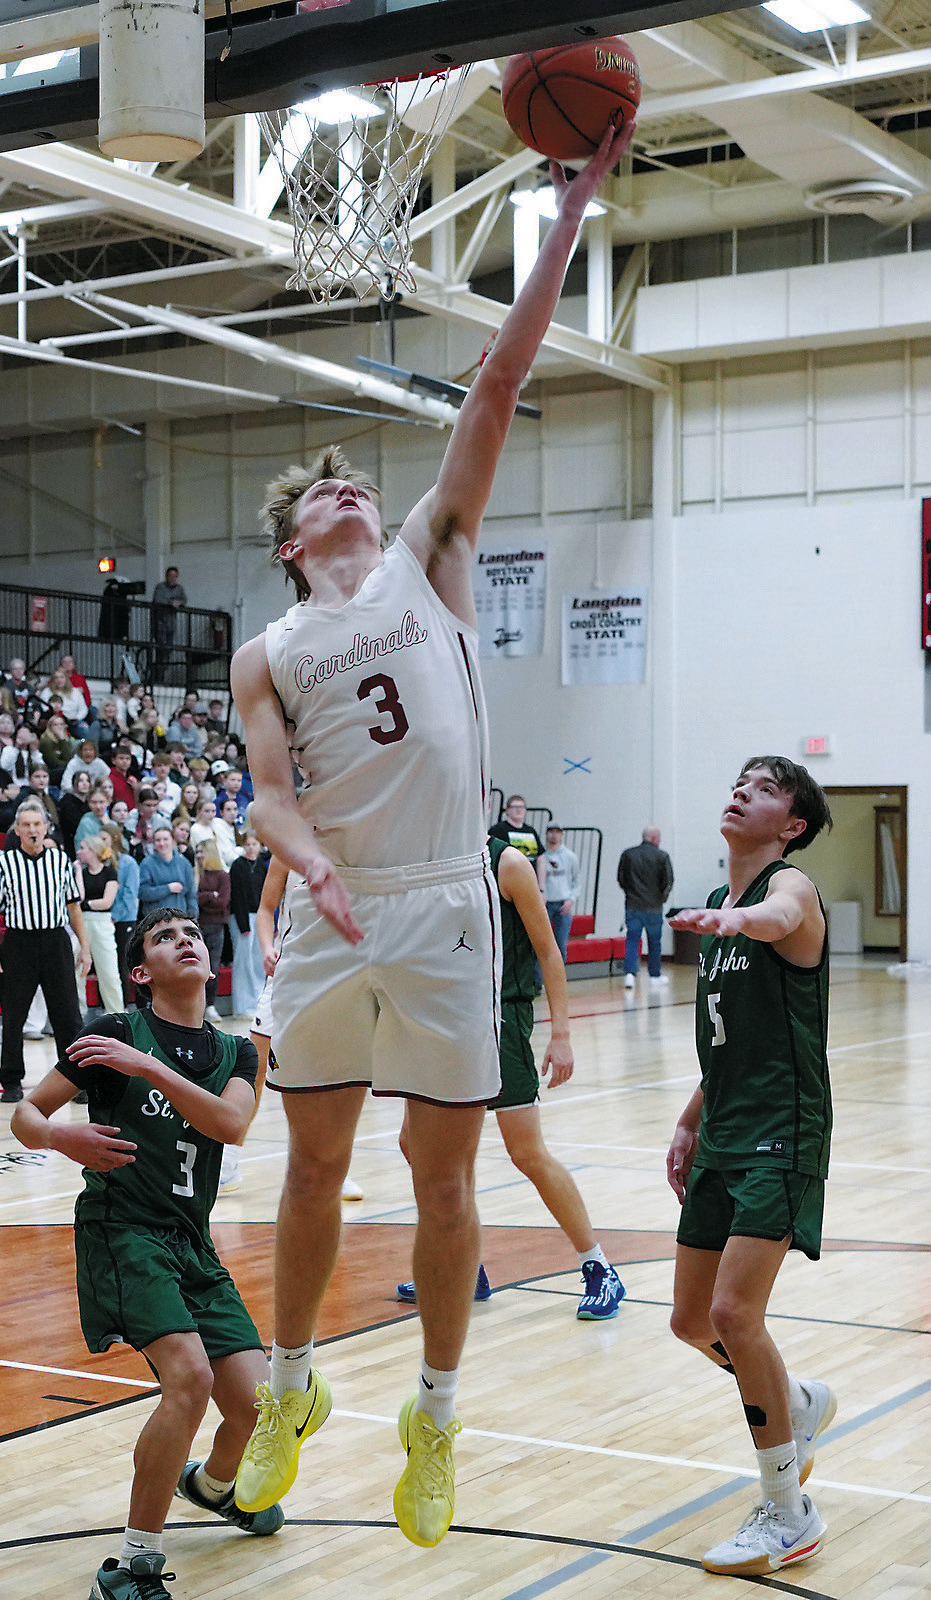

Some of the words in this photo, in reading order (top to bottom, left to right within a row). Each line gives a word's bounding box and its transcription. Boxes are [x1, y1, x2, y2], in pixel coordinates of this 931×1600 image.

[478, 551, 545, 565] Langdon
[491, 576, 530, 587] STATE
[571, 596, 643, 611] Langdon
[570, 619, 596, 629] CROSS
[599, 617, 642, 627] COUNTRY
[585, 630, 625, 639] STATE
[294, 610, 428, 694] Cardinals
[356, 672, 410, 746] 3
[707, 992, 727, 1047] 5
[141, 1088, 174, 1120] St.
[171, 1139, 198, 1198] 3
